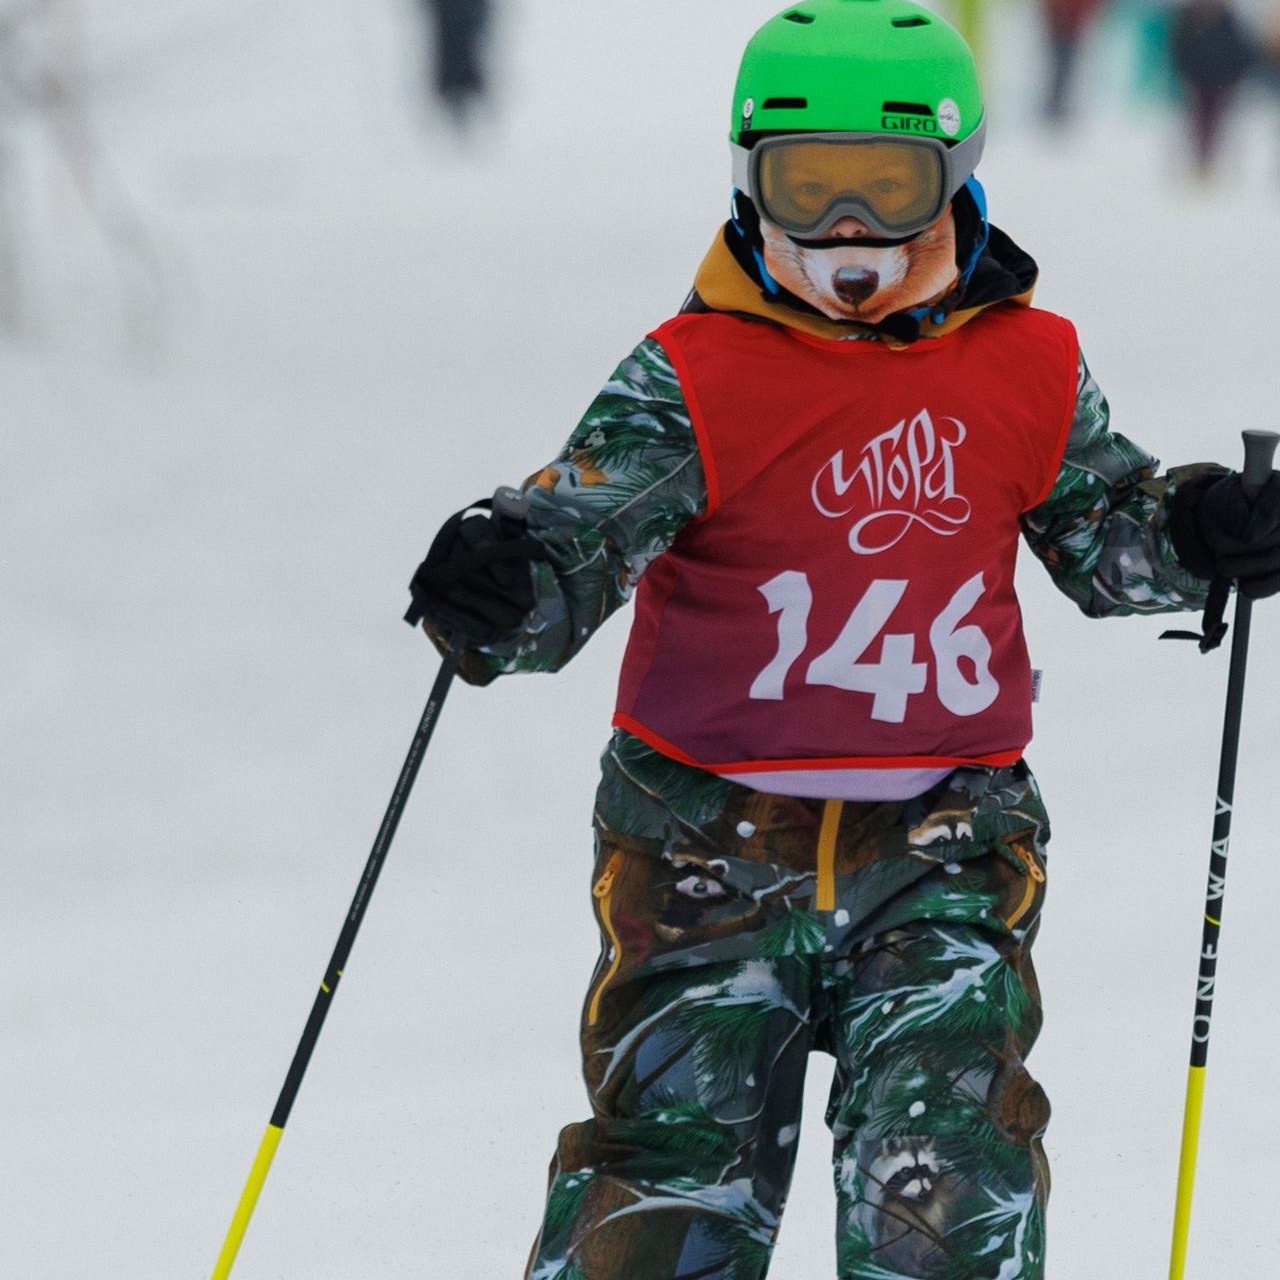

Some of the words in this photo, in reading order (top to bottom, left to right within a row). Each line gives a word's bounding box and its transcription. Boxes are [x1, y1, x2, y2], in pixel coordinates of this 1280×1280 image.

[881, 116, 937, 133] GIRO
[749, 569, 1000, 723] 146
[1192, 937, 1218, 1043] ONE
[1206, 794, 1233, 902] WAY
